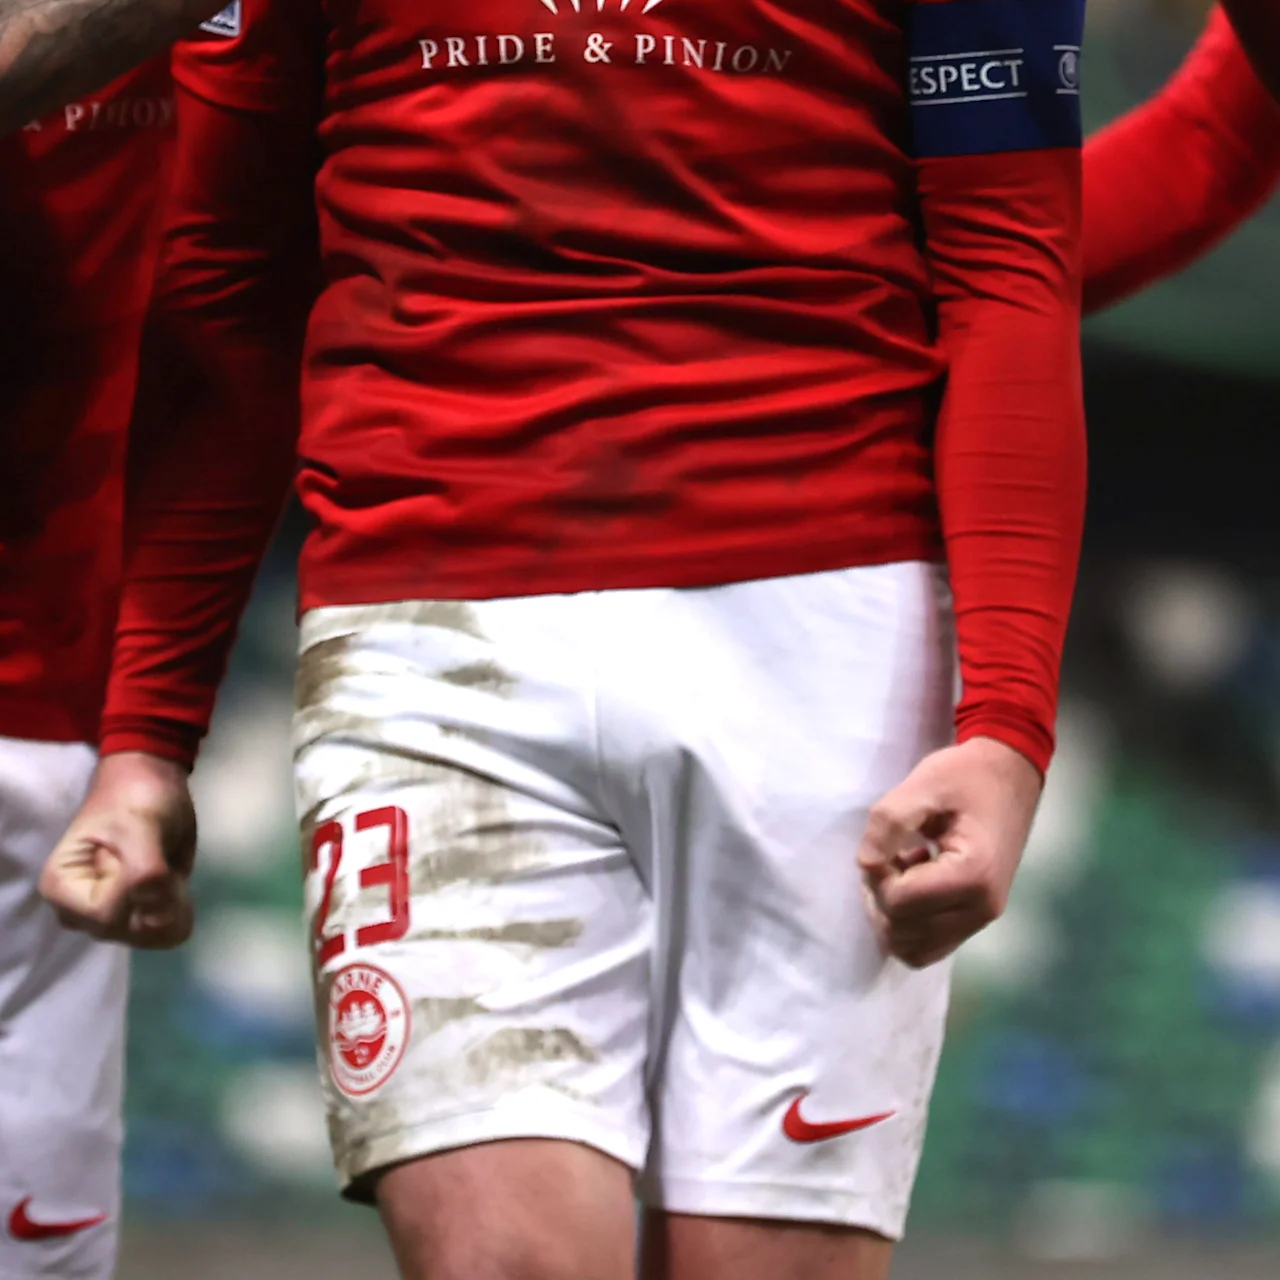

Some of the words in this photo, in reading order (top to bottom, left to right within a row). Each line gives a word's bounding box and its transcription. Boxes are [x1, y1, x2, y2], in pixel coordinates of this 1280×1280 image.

[418, 32, 556, 70] PRIDE
[582, 31, 615, 65] &
[634, 32, 793, 74] PINION
[909, 59, 1024, 96] ESPECT
[311, 804, 410, 966] 23
